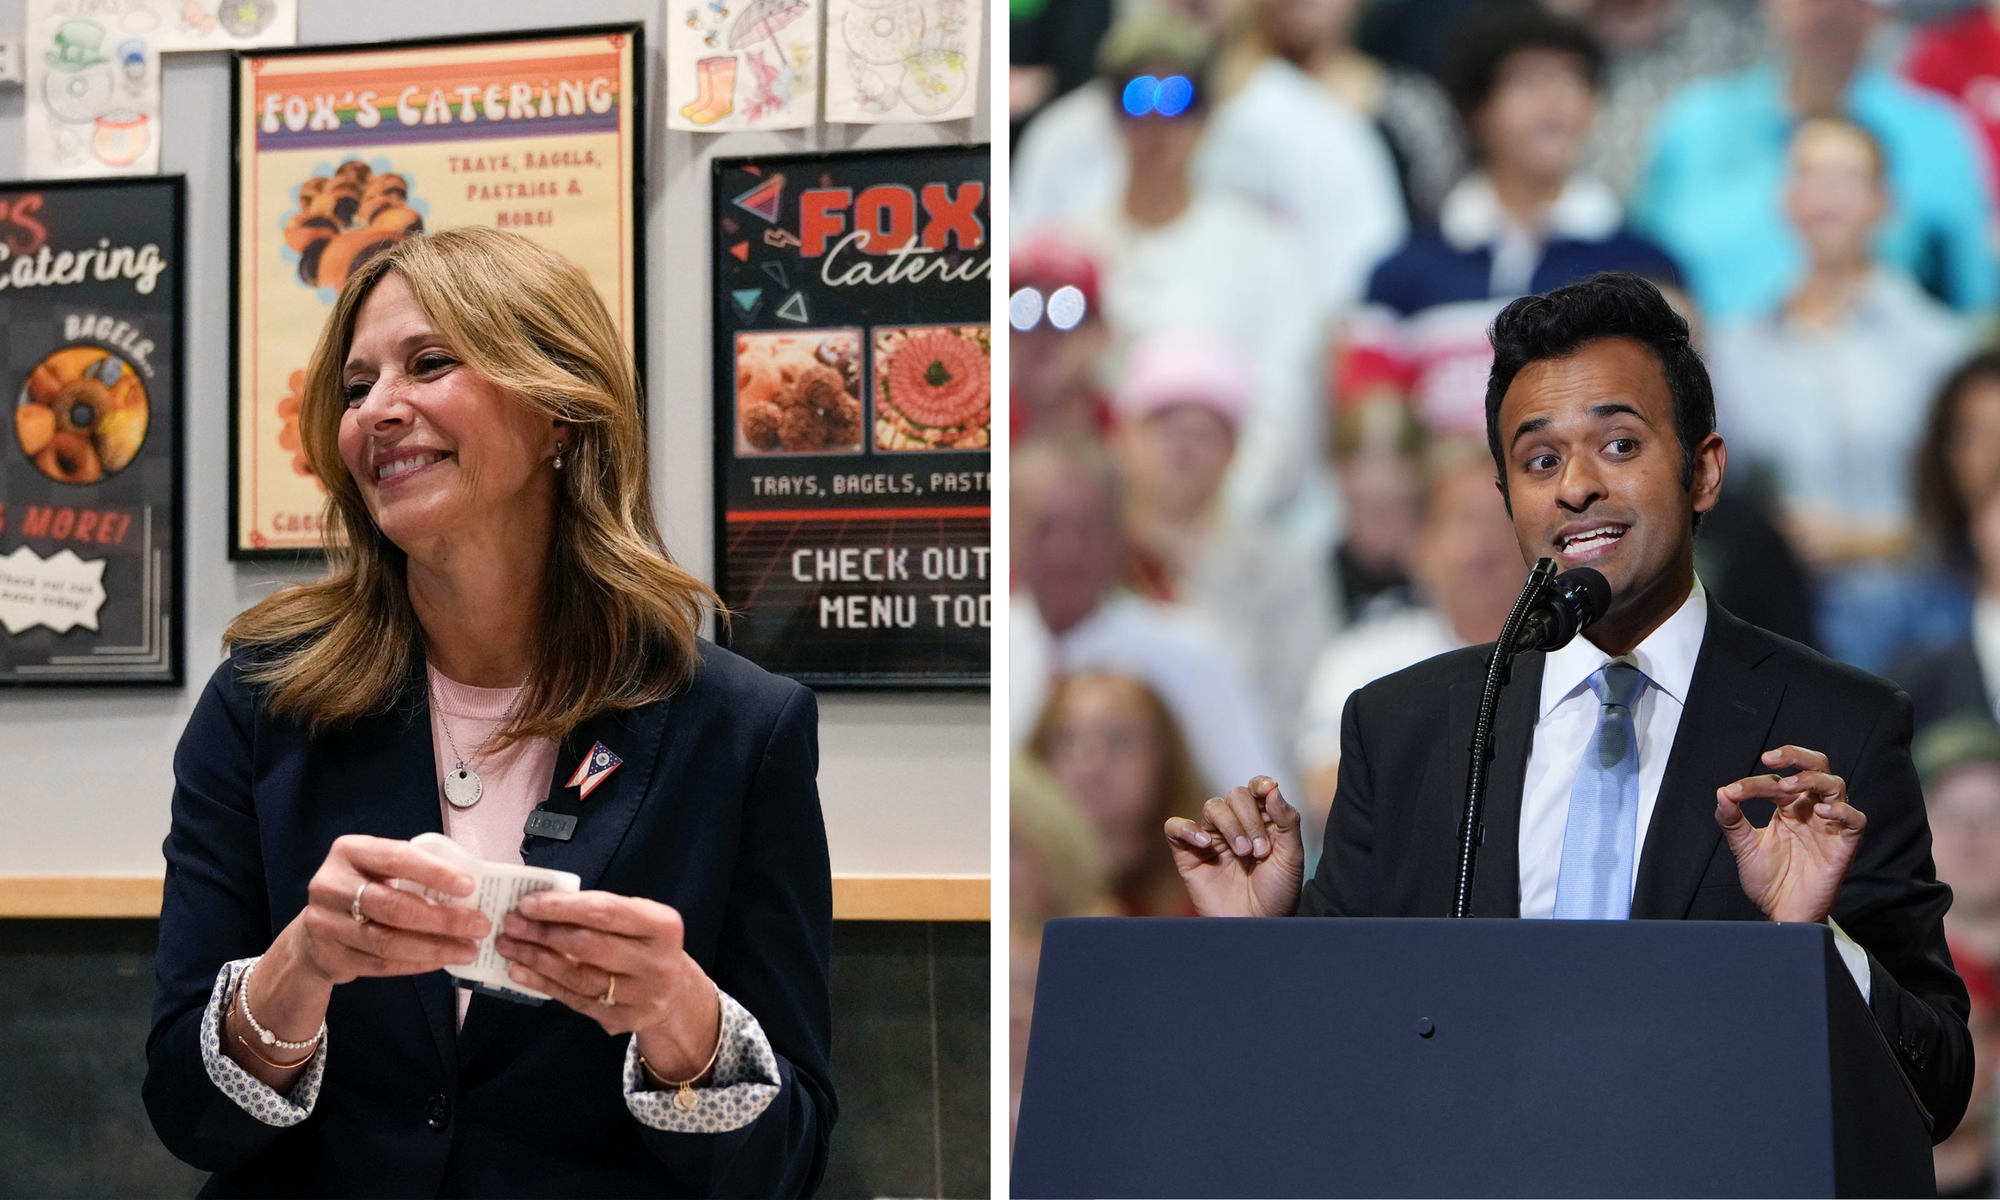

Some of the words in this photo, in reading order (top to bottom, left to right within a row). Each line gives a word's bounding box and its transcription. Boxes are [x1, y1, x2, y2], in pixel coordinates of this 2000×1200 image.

[260, 90, 382, 134] FOX'S
[448, 156, 518, 173] TRAYS,
[525, 150, 603, 169] BAGELS,
[468, 181, 558, 200] PASTRIES
[567, 178, 582, 195] &
[800, 182, 990, 258] FOX
[821, 229, 990, 286] Cateri
[751, 475, 827, 498] TRAYS,
[833, 473, 924, 496] BAGELS,
[21, 504, 132, 545] MORE!
[792, 548, 909, 582] CHECK
[922, 547, 990, 580] OUT
[820, 596, 917, 629] MENU
